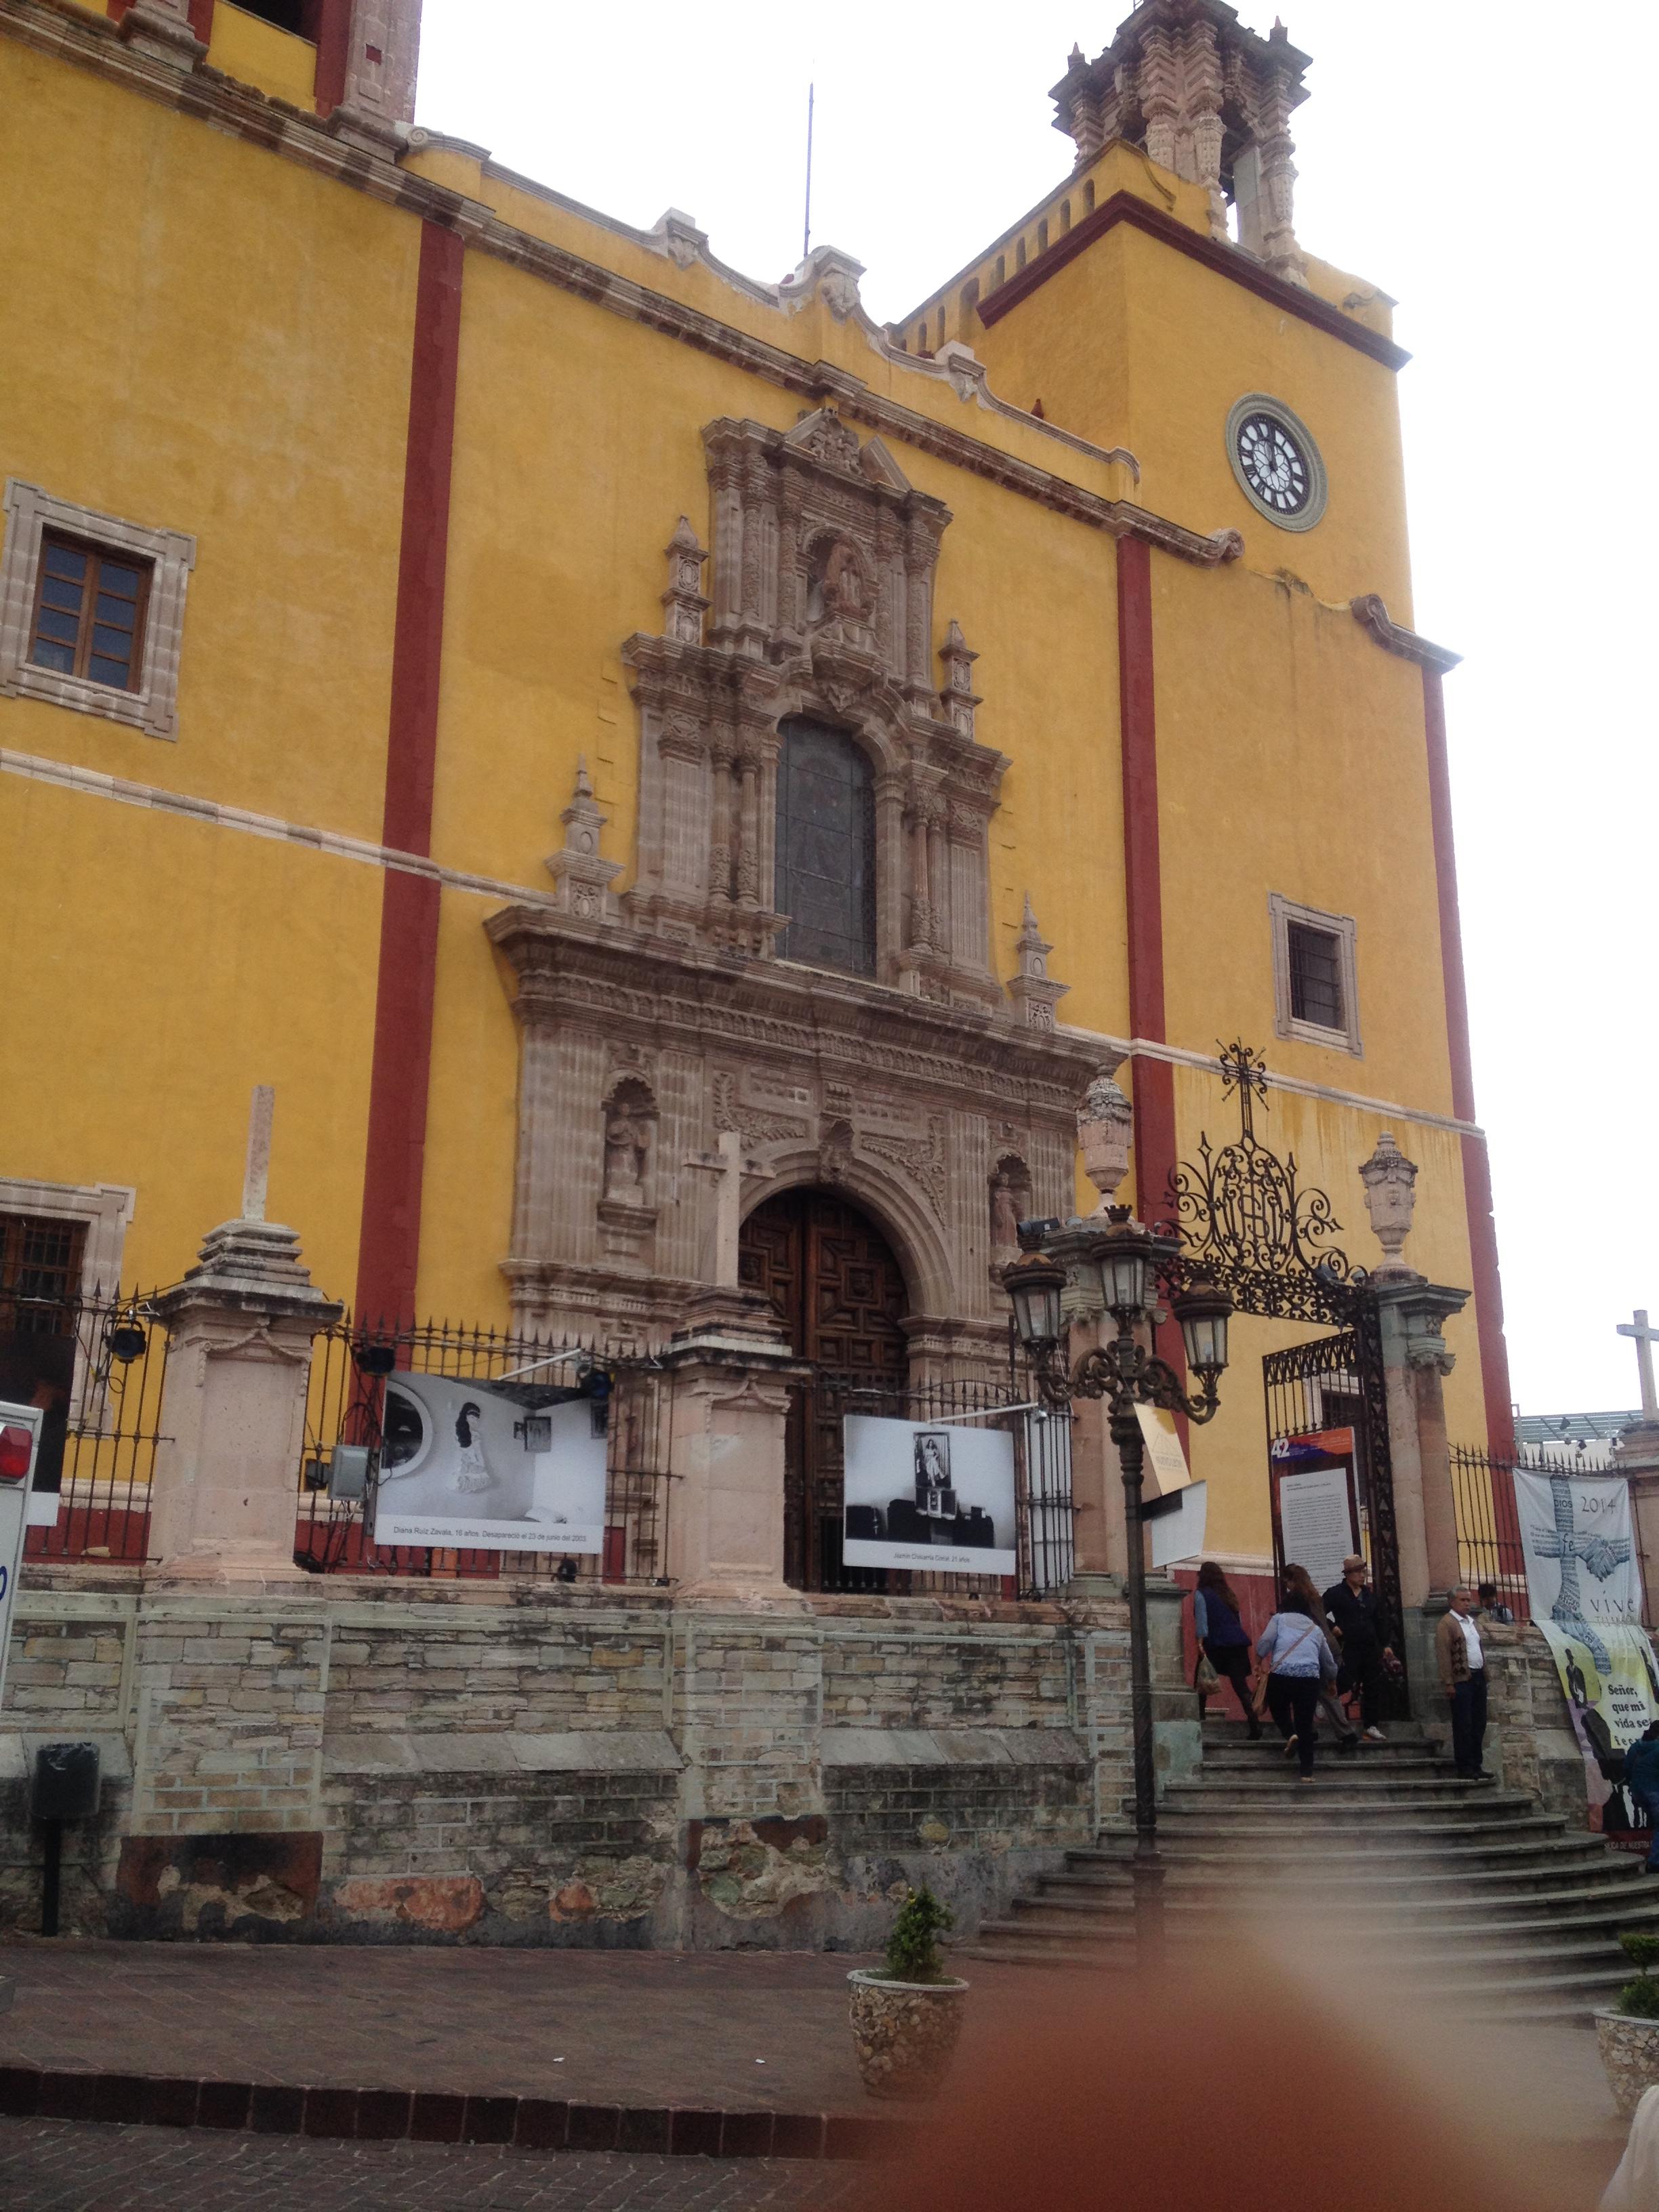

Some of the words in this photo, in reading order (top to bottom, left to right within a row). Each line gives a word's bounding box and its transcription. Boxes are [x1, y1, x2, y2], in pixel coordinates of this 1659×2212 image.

[1272, 1437, 1290, 1458] 42
[1580, 1496, 1616, 1514] 2014
[394, 1526, 412, 1534] Diana
[1561, 1533, 1576, 1557] fe
[1607, 1684, 1638, 1697] Señor,
[1612, 1703, 1629, 1715] que
[1630, 1701, 1646, 1712] mi
[1614, 1718, 1636, 1729] vida
